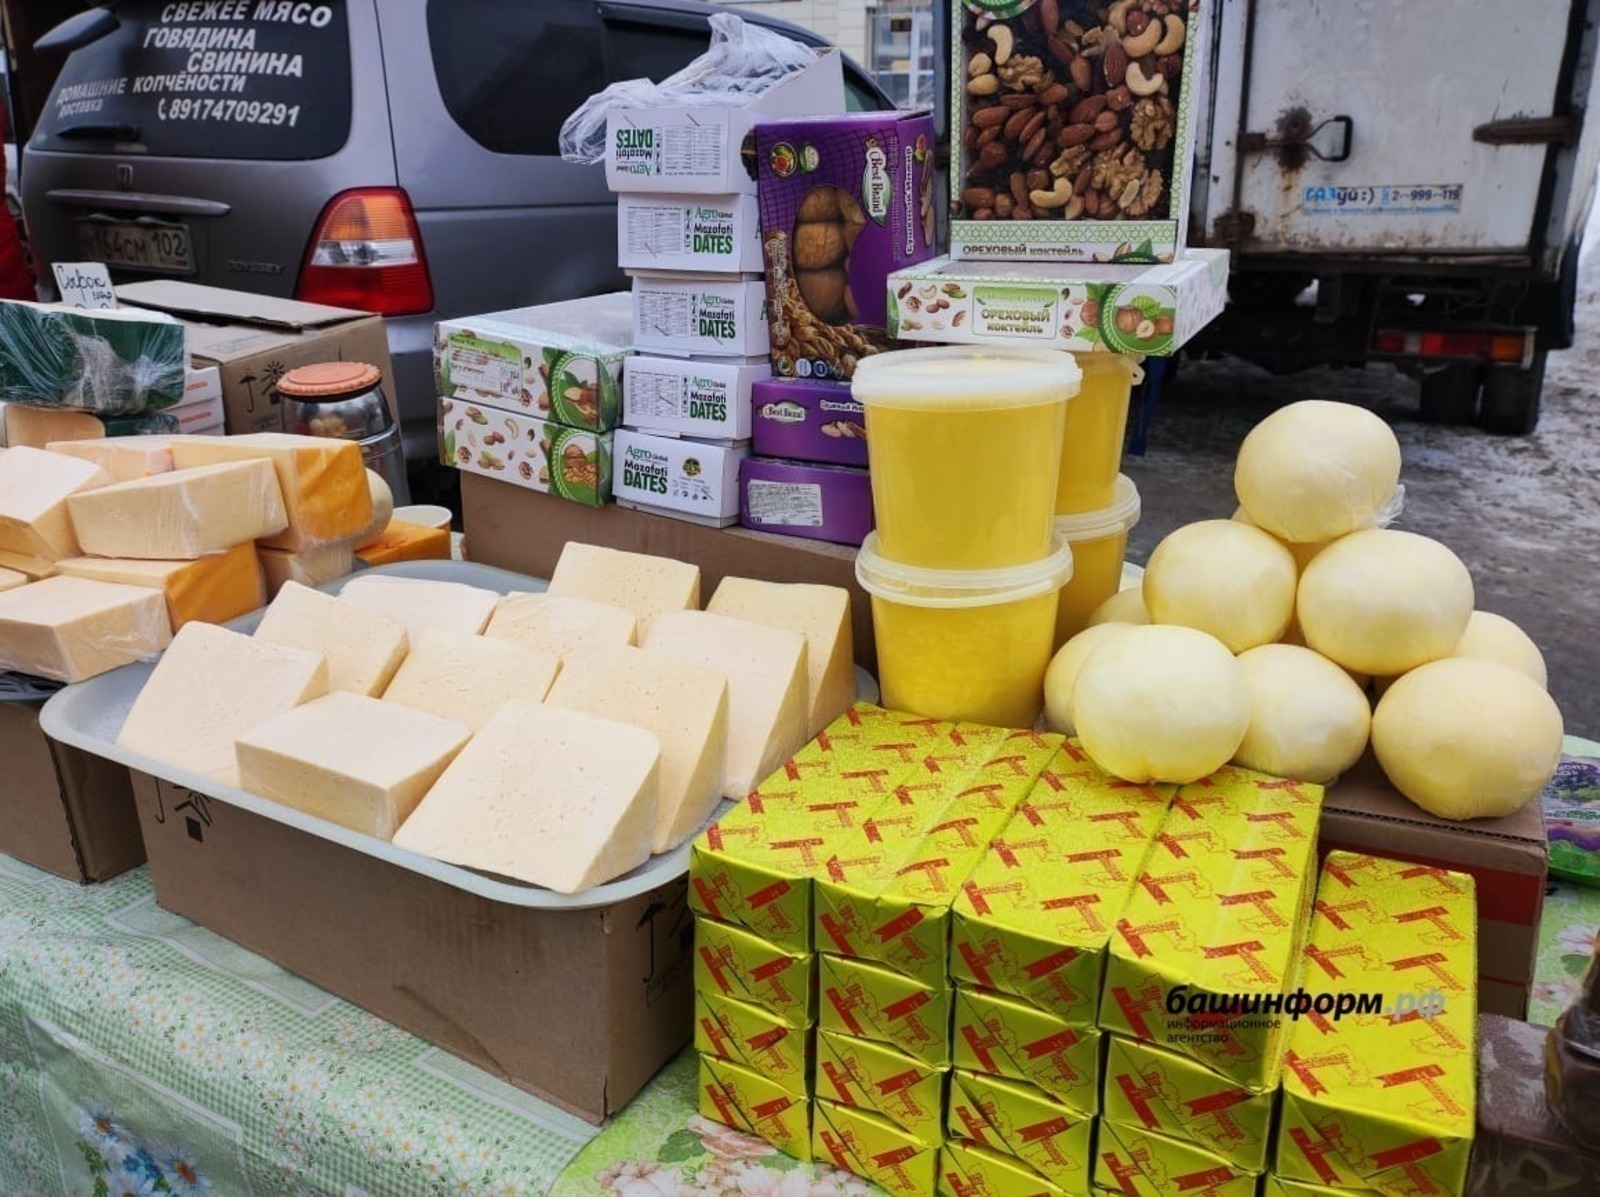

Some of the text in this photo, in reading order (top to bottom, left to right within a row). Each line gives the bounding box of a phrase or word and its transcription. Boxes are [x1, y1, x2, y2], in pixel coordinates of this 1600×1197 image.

[161, 1, 333, 28] СВЕЖЕЕ МЯСО
[143, 27, 256, 51] ГОВЯДИНА
[187, 51, 303, 77] СВИНИНА
[132, 71, 247, 94] КОПЧЁНОСТИ
[169, 98, 300, 127] 89174709291
[616, 129, 653, 149] DATES
[630, 161, 652, 177] Agro
[868, 152, 885, 180] Best
[694, 206, 718, 222] Agro
[693, 234, 733, 254] DATES
[962, 243, 1027, 256] ОРЕХОВЫЙ
[700, 291, 721, 308] Agro
[981, 308, 1050, 323] ОРЕХОВЫЙ
[699, 319, 736, 339] DATES
[690, 375, 713, 391] Agro
[690, 401, 727, 422] DATES
[625, 444, 653, 460] Agro
[623, 468, 668, 495] DATES
